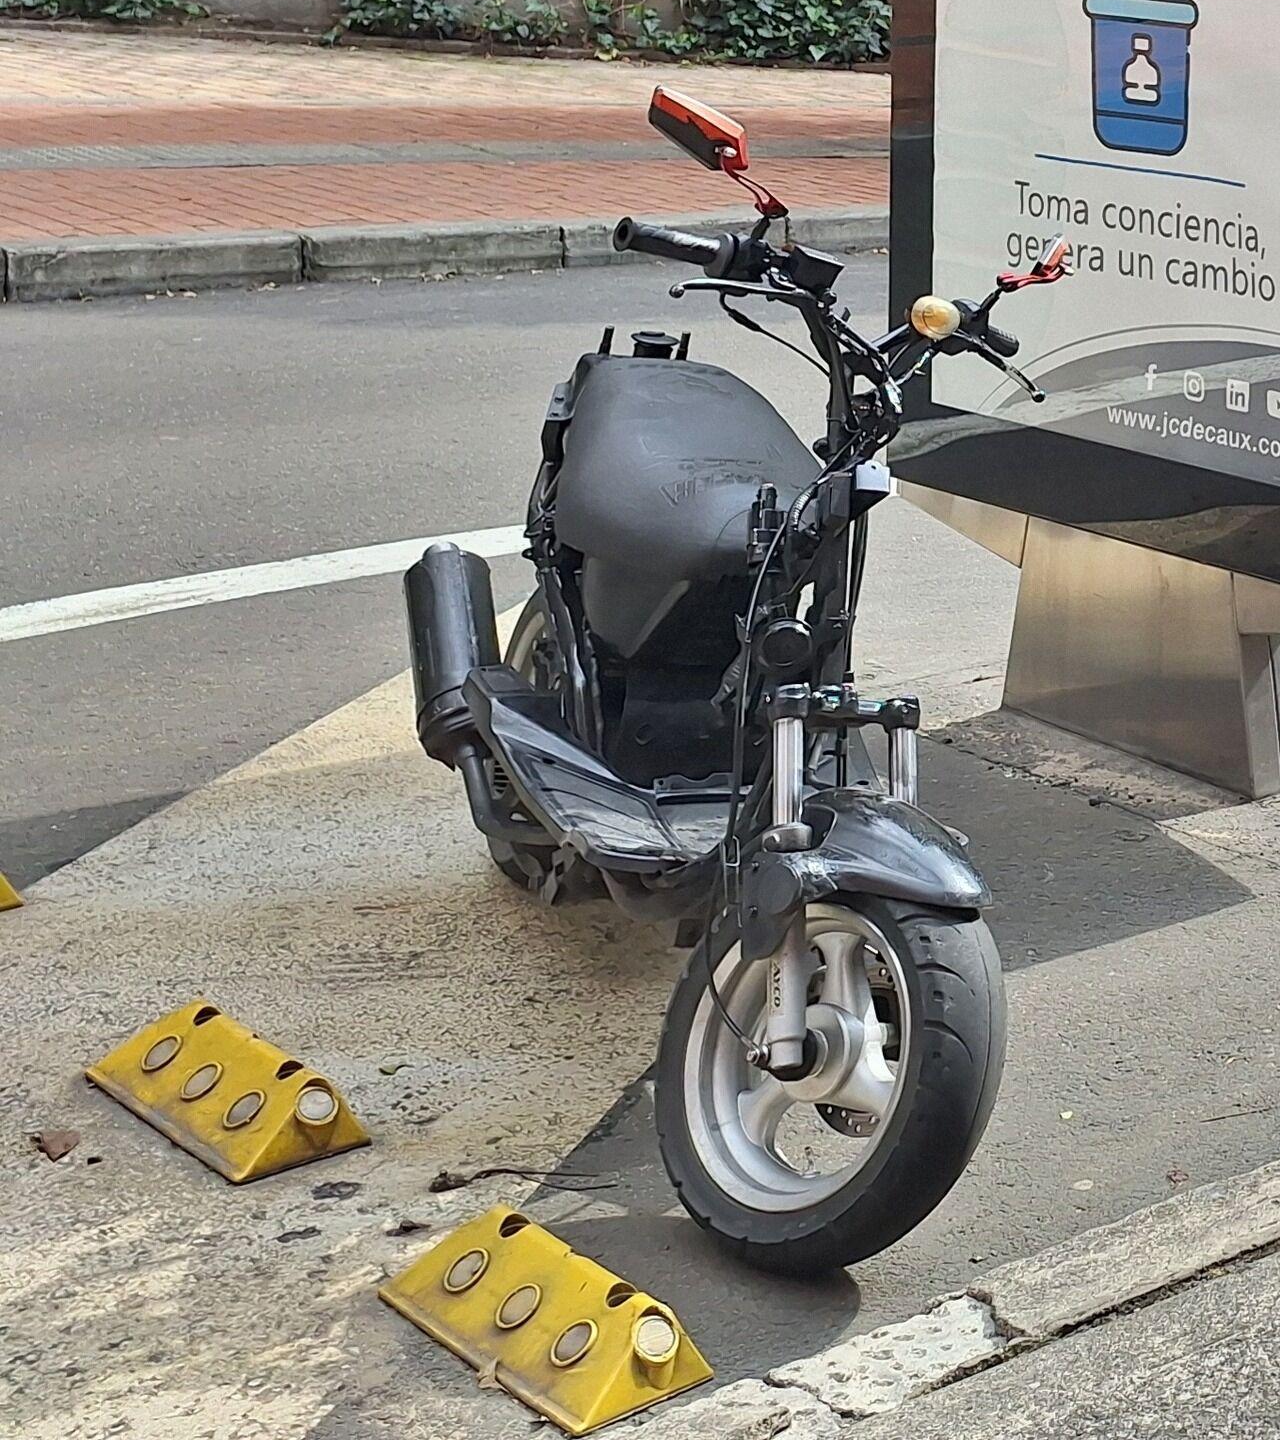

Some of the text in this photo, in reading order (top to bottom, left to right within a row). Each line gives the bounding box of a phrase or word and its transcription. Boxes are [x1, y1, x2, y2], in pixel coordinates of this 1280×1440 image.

[1014, 180, 1266, 260] Toma conciencia,
[1118, 248, 1153, 281] un
[1165, 257, 1276, 302] cambio
